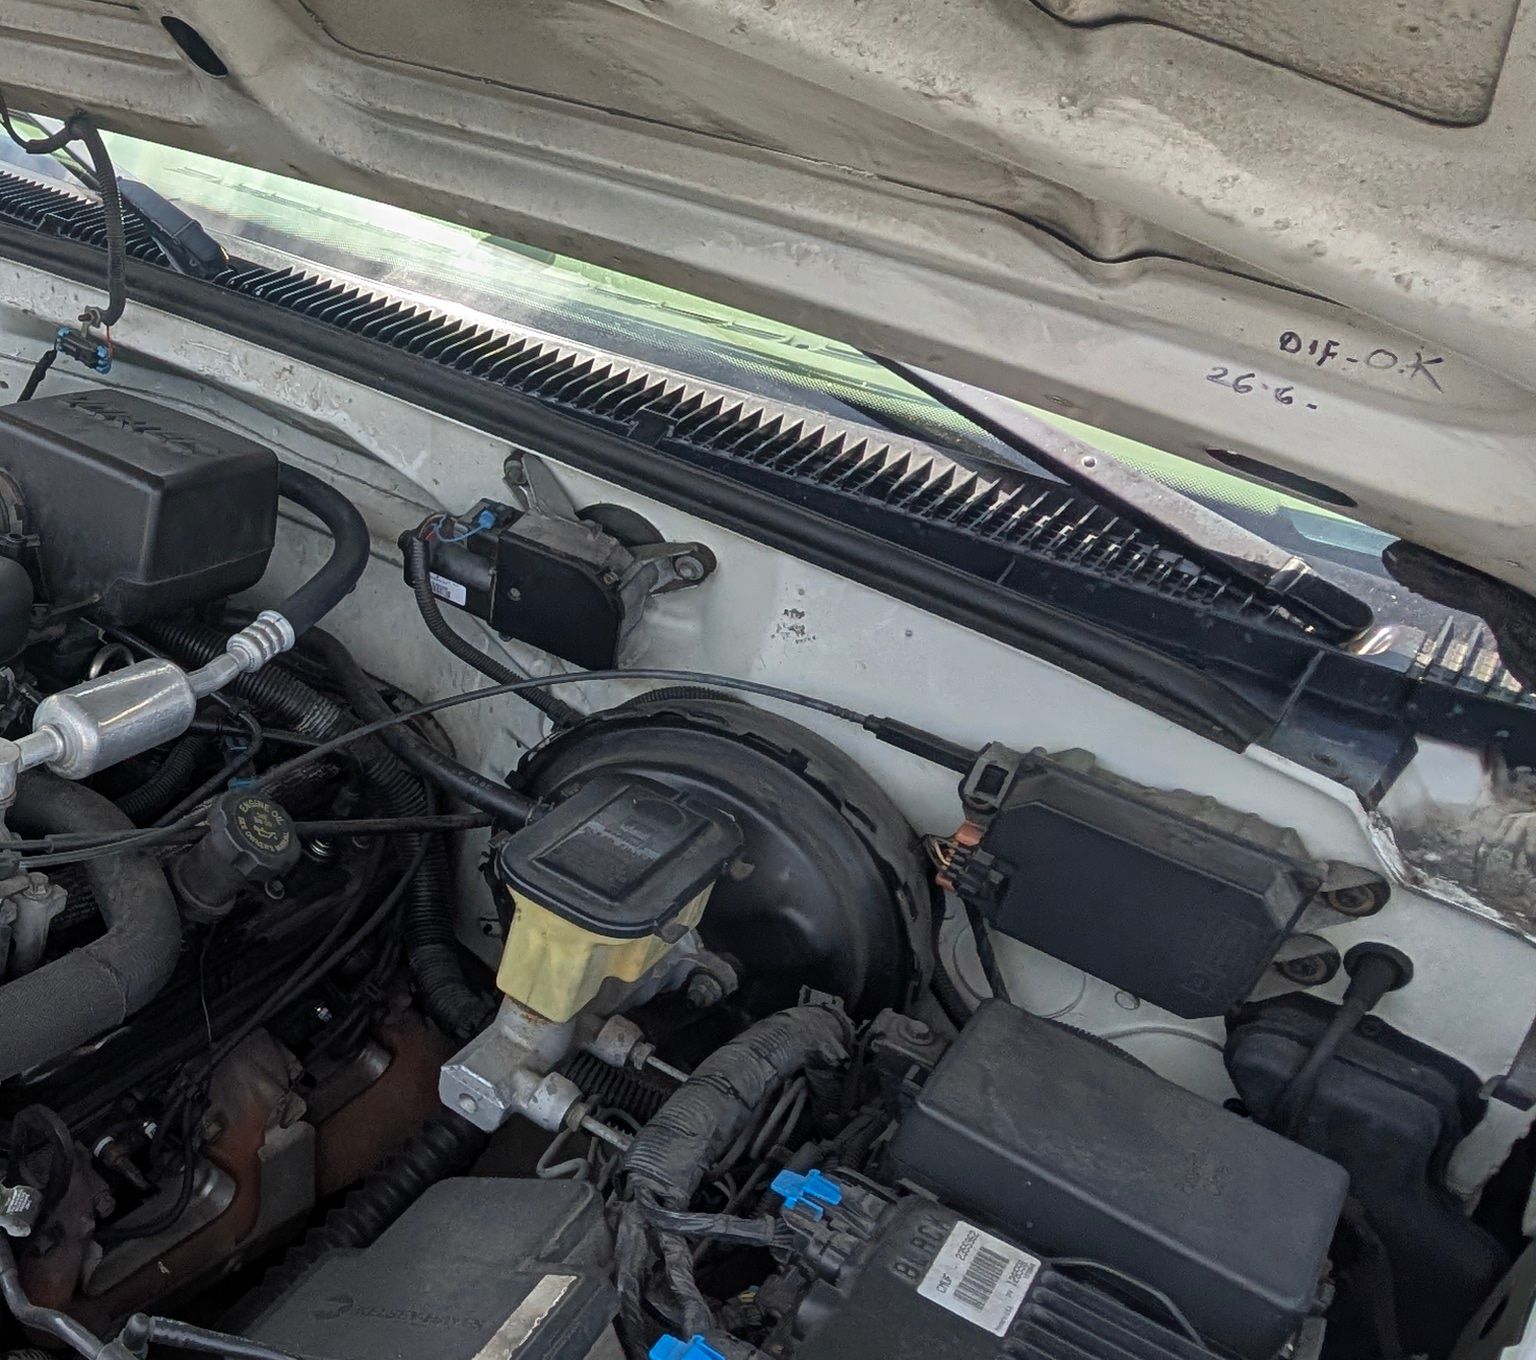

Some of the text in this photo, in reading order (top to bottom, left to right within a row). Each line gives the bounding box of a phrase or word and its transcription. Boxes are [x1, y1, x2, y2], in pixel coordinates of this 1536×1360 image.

[239, 798, 284, 825] ENGINE OIL
[894, 1215, 951, 1283] BLACK
